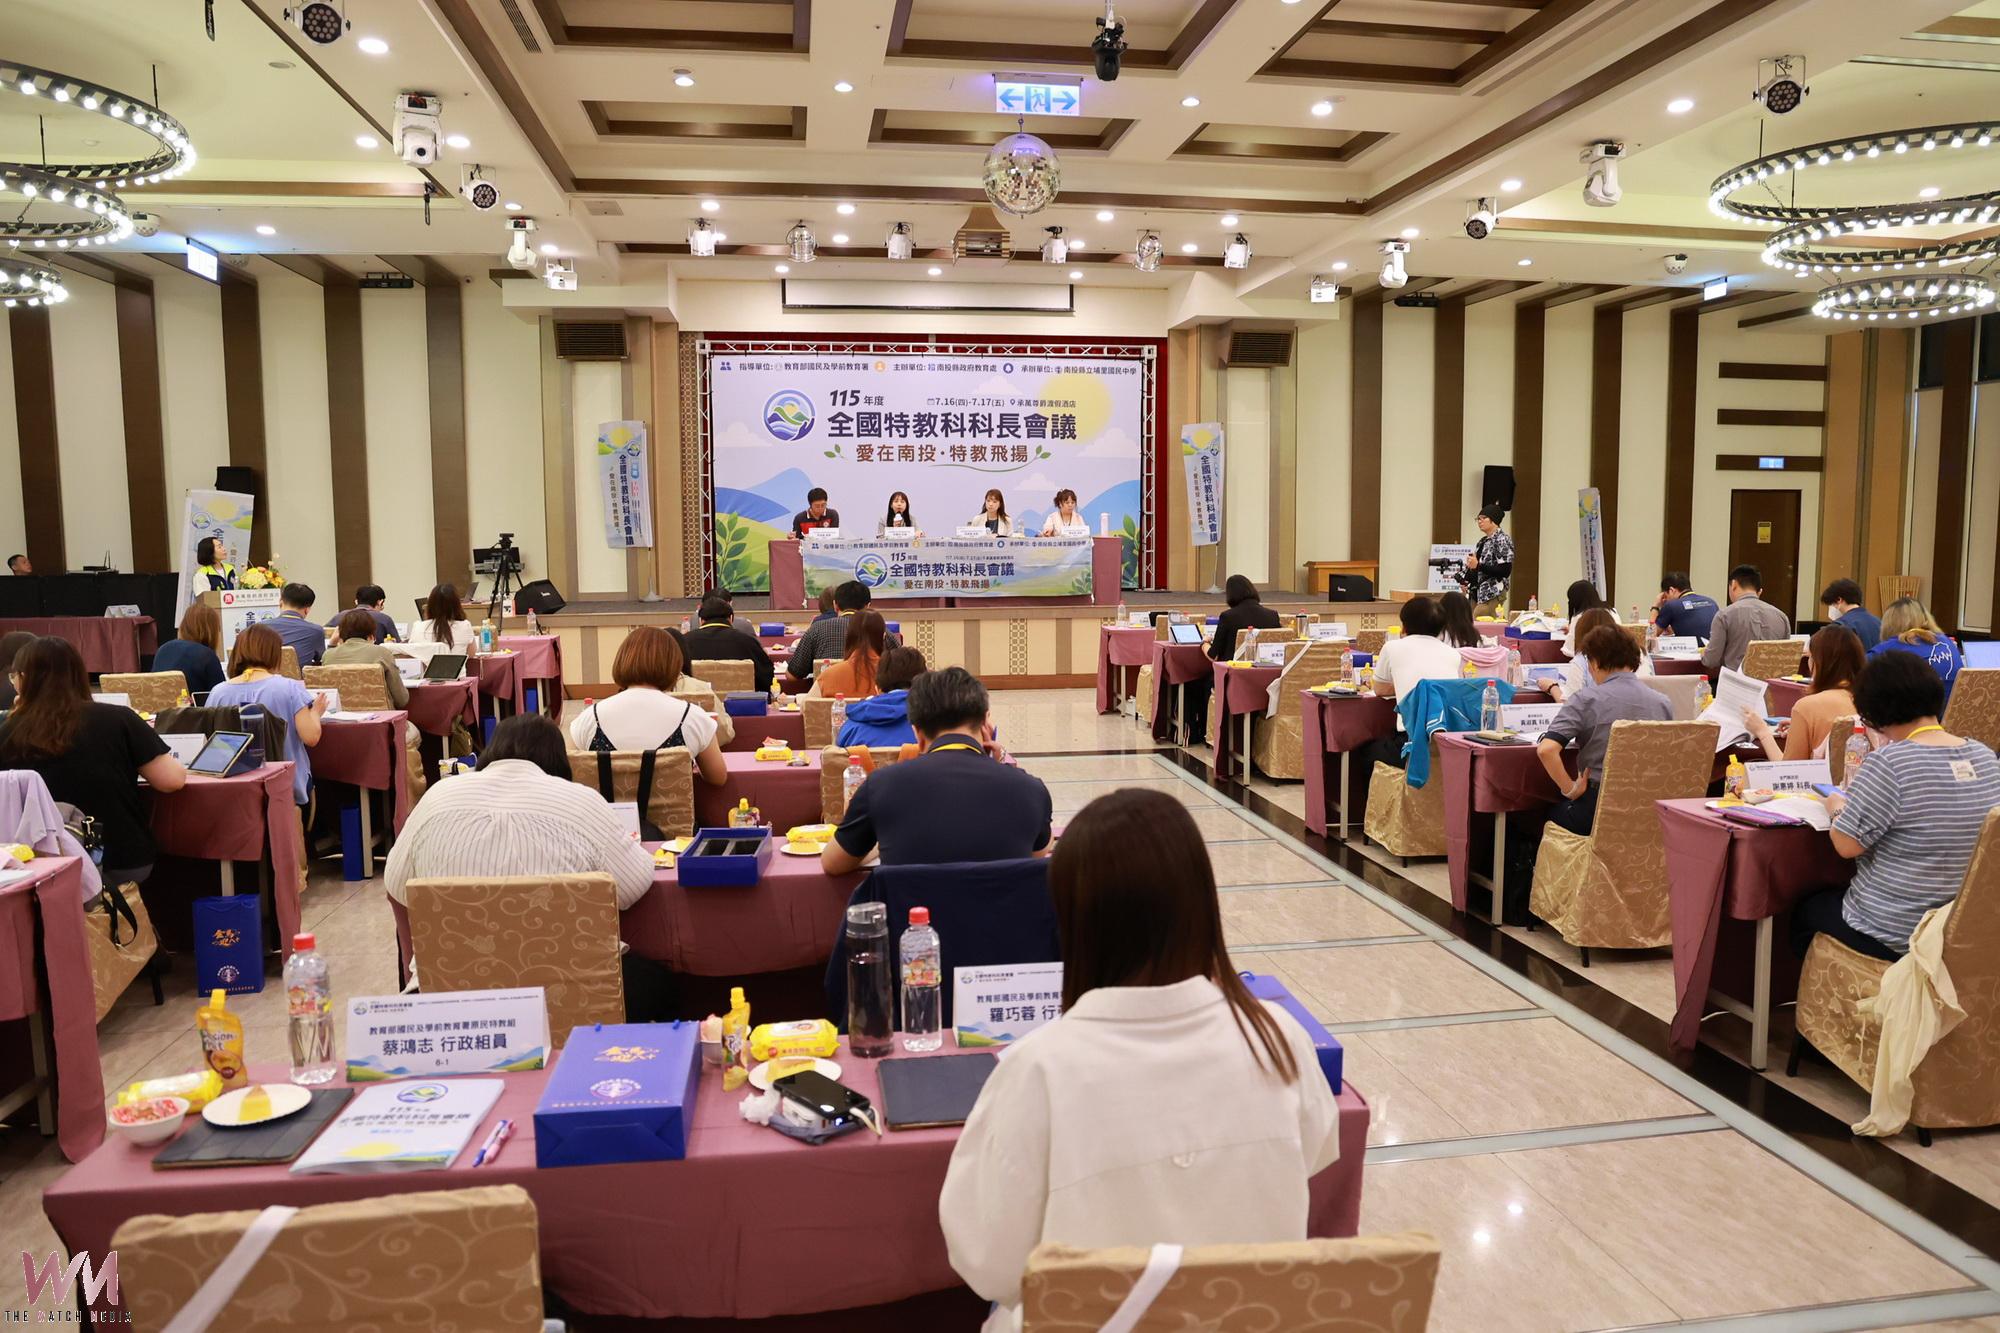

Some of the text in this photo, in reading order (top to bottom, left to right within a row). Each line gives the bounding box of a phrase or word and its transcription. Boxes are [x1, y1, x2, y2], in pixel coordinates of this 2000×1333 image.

[784, 361, 869, 372] 教育部國民及學前教育署
[936, 363, 998, 373] 南投縣政府教育處
[1063, 365, 1137, 376] 南投縣立埔里國民中學
[829, 389, 884, 407] 115 年度
[827, 411, 1077, 440] 全國特教科科長會議
[856, 443, 1029, 463] 愛在南投·特教飛揚
[891, 552, 906, 562] 115
[890, 562, 1015, 577] 全國特教科科長會議
[976, 991, 1062, 1004] 教育部國民及學前教育
[990, 1006, 1035, 1022] 羅巧蓉
[369, 1018, 516, 1036] 教育部國民及學前教育署原民特教組
[383, 1033, 507, 1056] 蔡鴻志 行政組員
